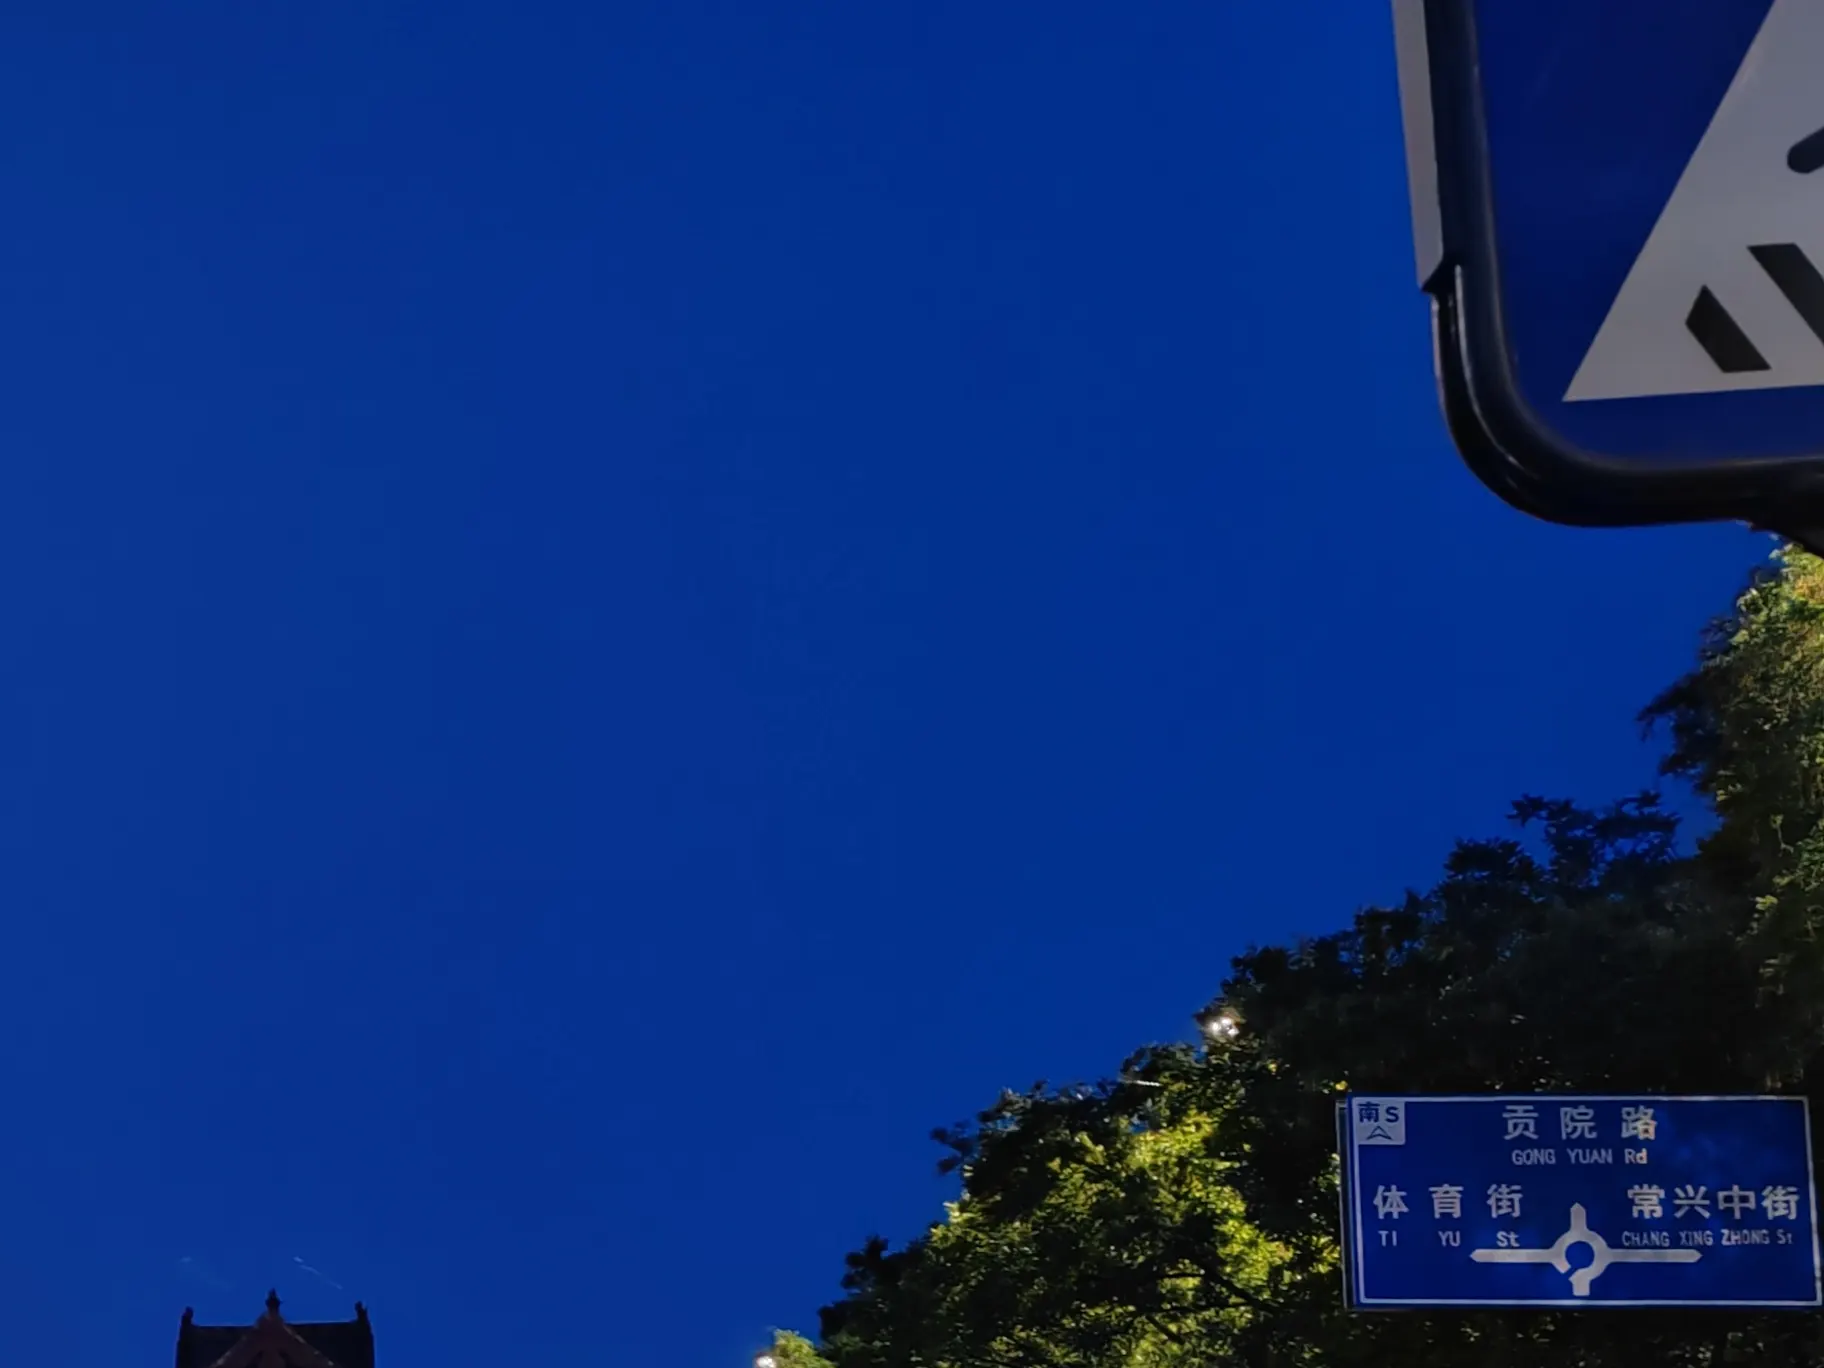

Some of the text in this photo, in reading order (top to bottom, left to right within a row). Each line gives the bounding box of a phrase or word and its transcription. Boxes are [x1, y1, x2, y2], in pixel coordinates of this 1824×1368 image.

[1502, 1105, 1658, 1140] 贡院路
[1512, 1148, 1648, 1165] GONG YUAN Rd
[1374, 1184, 1524, 1219] 体育街
[1628, 1185, 1800, 1220] 常兴中街
[1379, 1230, 1520, 1248] TI YU St
[1621, 1228, 1793, 1248] CHANG XING ZHONG St
